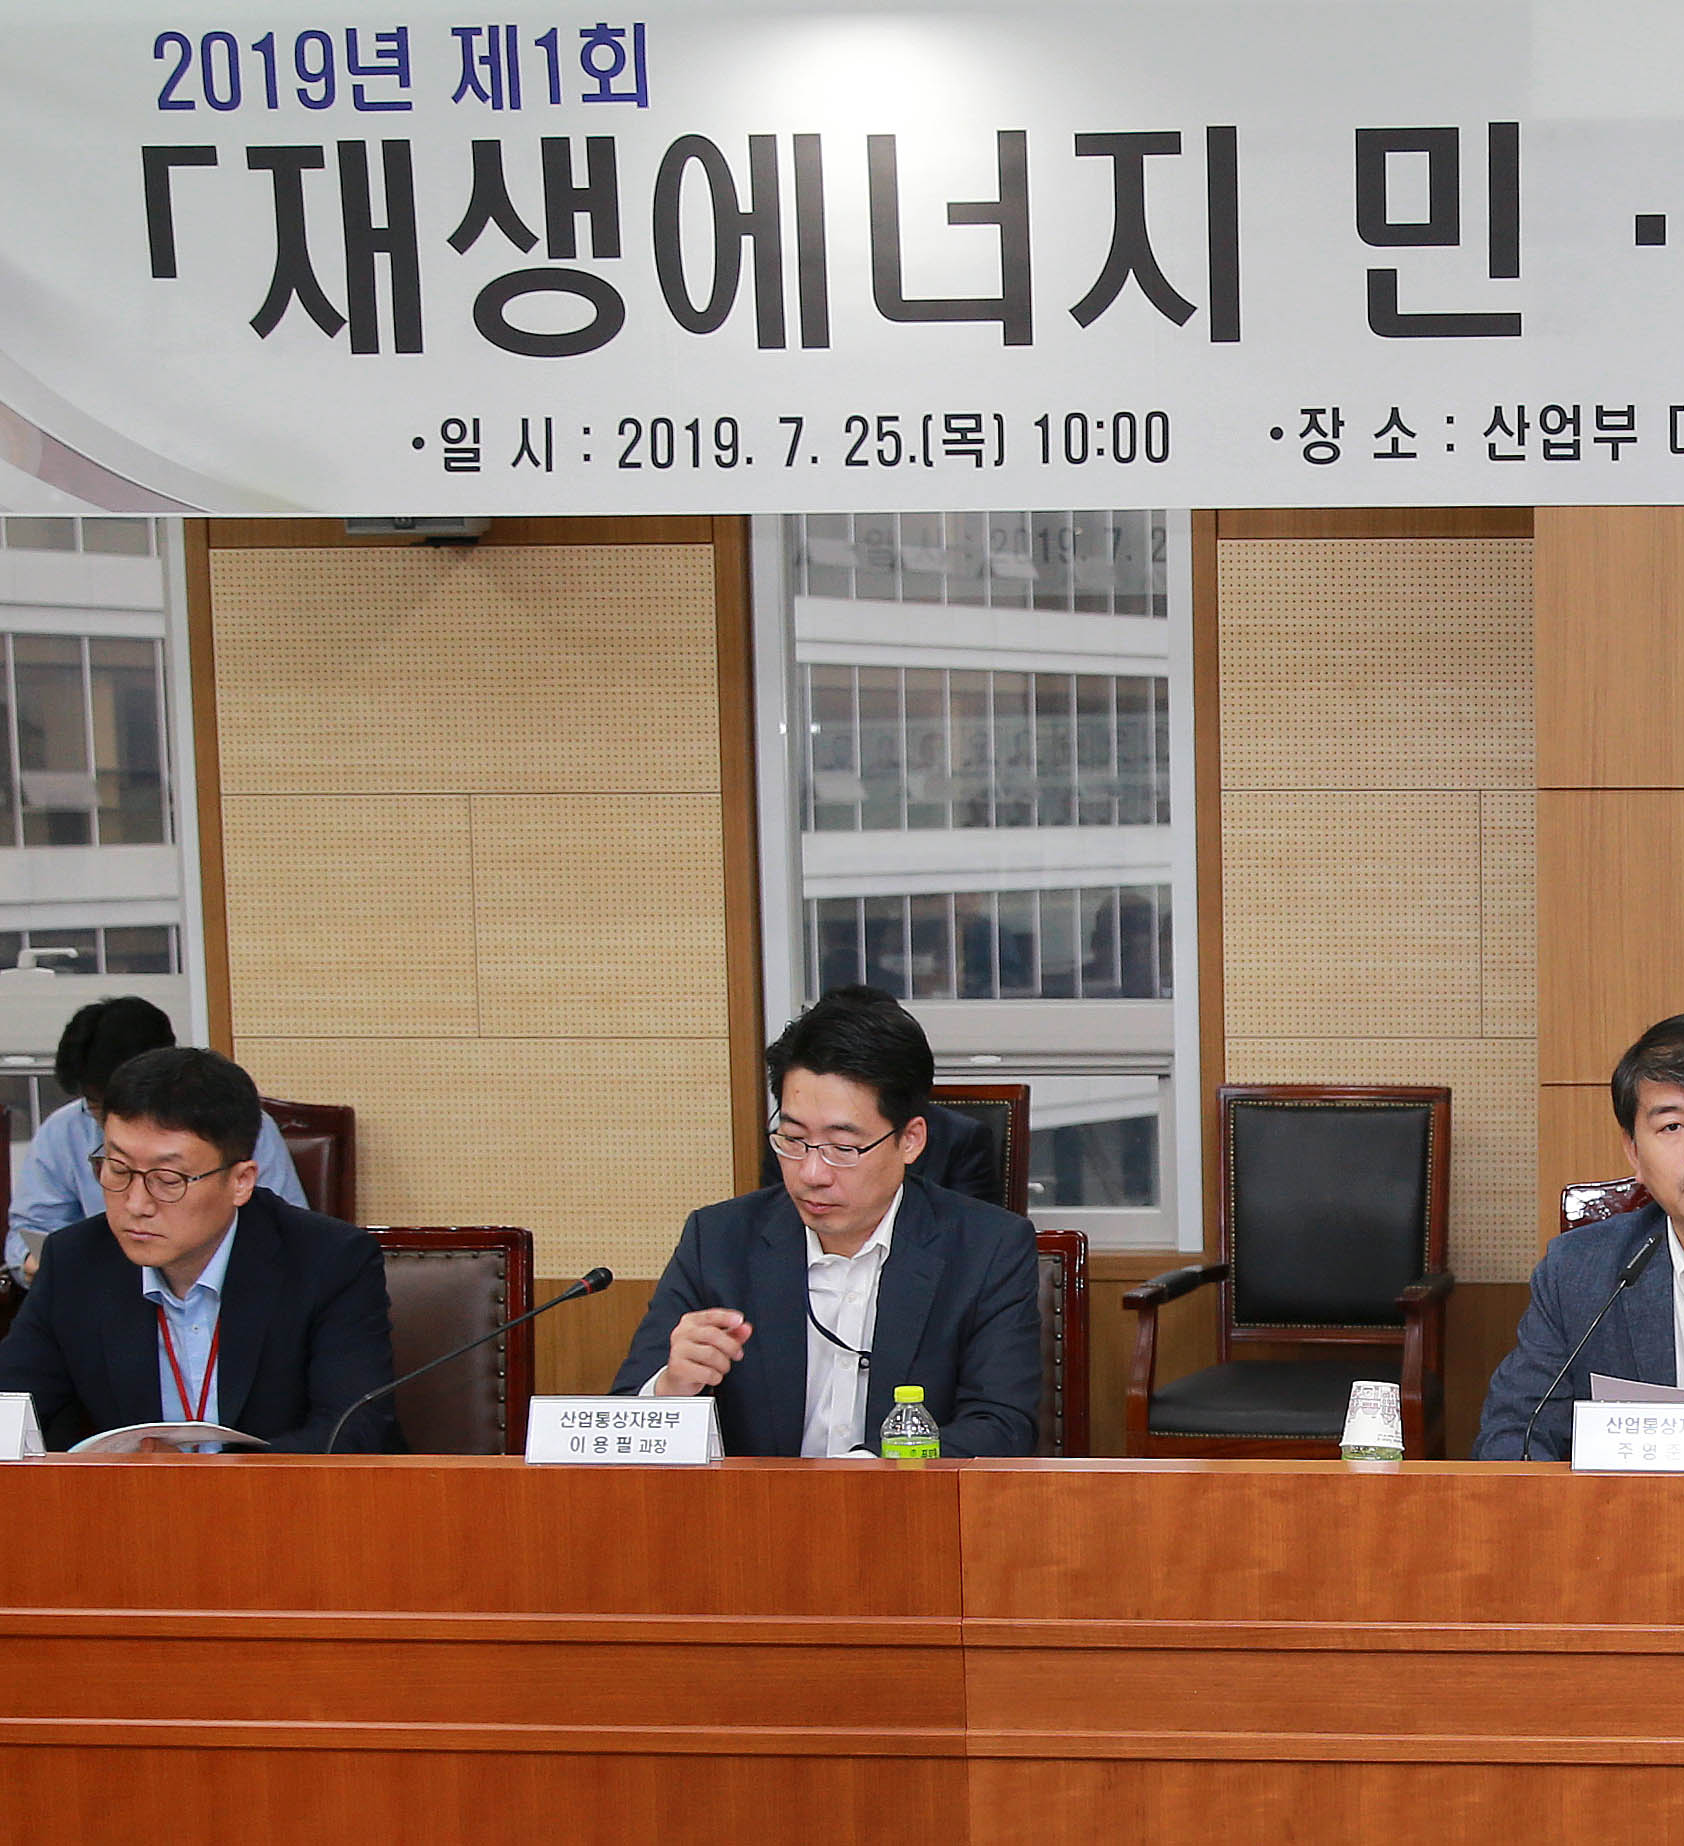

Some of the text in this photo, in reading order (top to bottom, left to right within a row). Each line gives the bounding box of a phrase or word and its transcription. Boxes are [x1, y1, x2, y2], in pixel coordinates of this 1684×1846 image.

[153, 22, 649, 112] 2019년 제1회
[1354, 121, 1522, 339] 민
[618, 416, 753, 469] 2019.
[779, 416, 818, 467] 7.
[844, 413, 1005, 468] 25.(목)
[1034, 410, 1170, 465] 10:00
[1483, 404, 1638, 462] 산업부
[560, 1411, 681, 1429] 산업통상자원부
[639, 1439, 667, 1454] 과장
